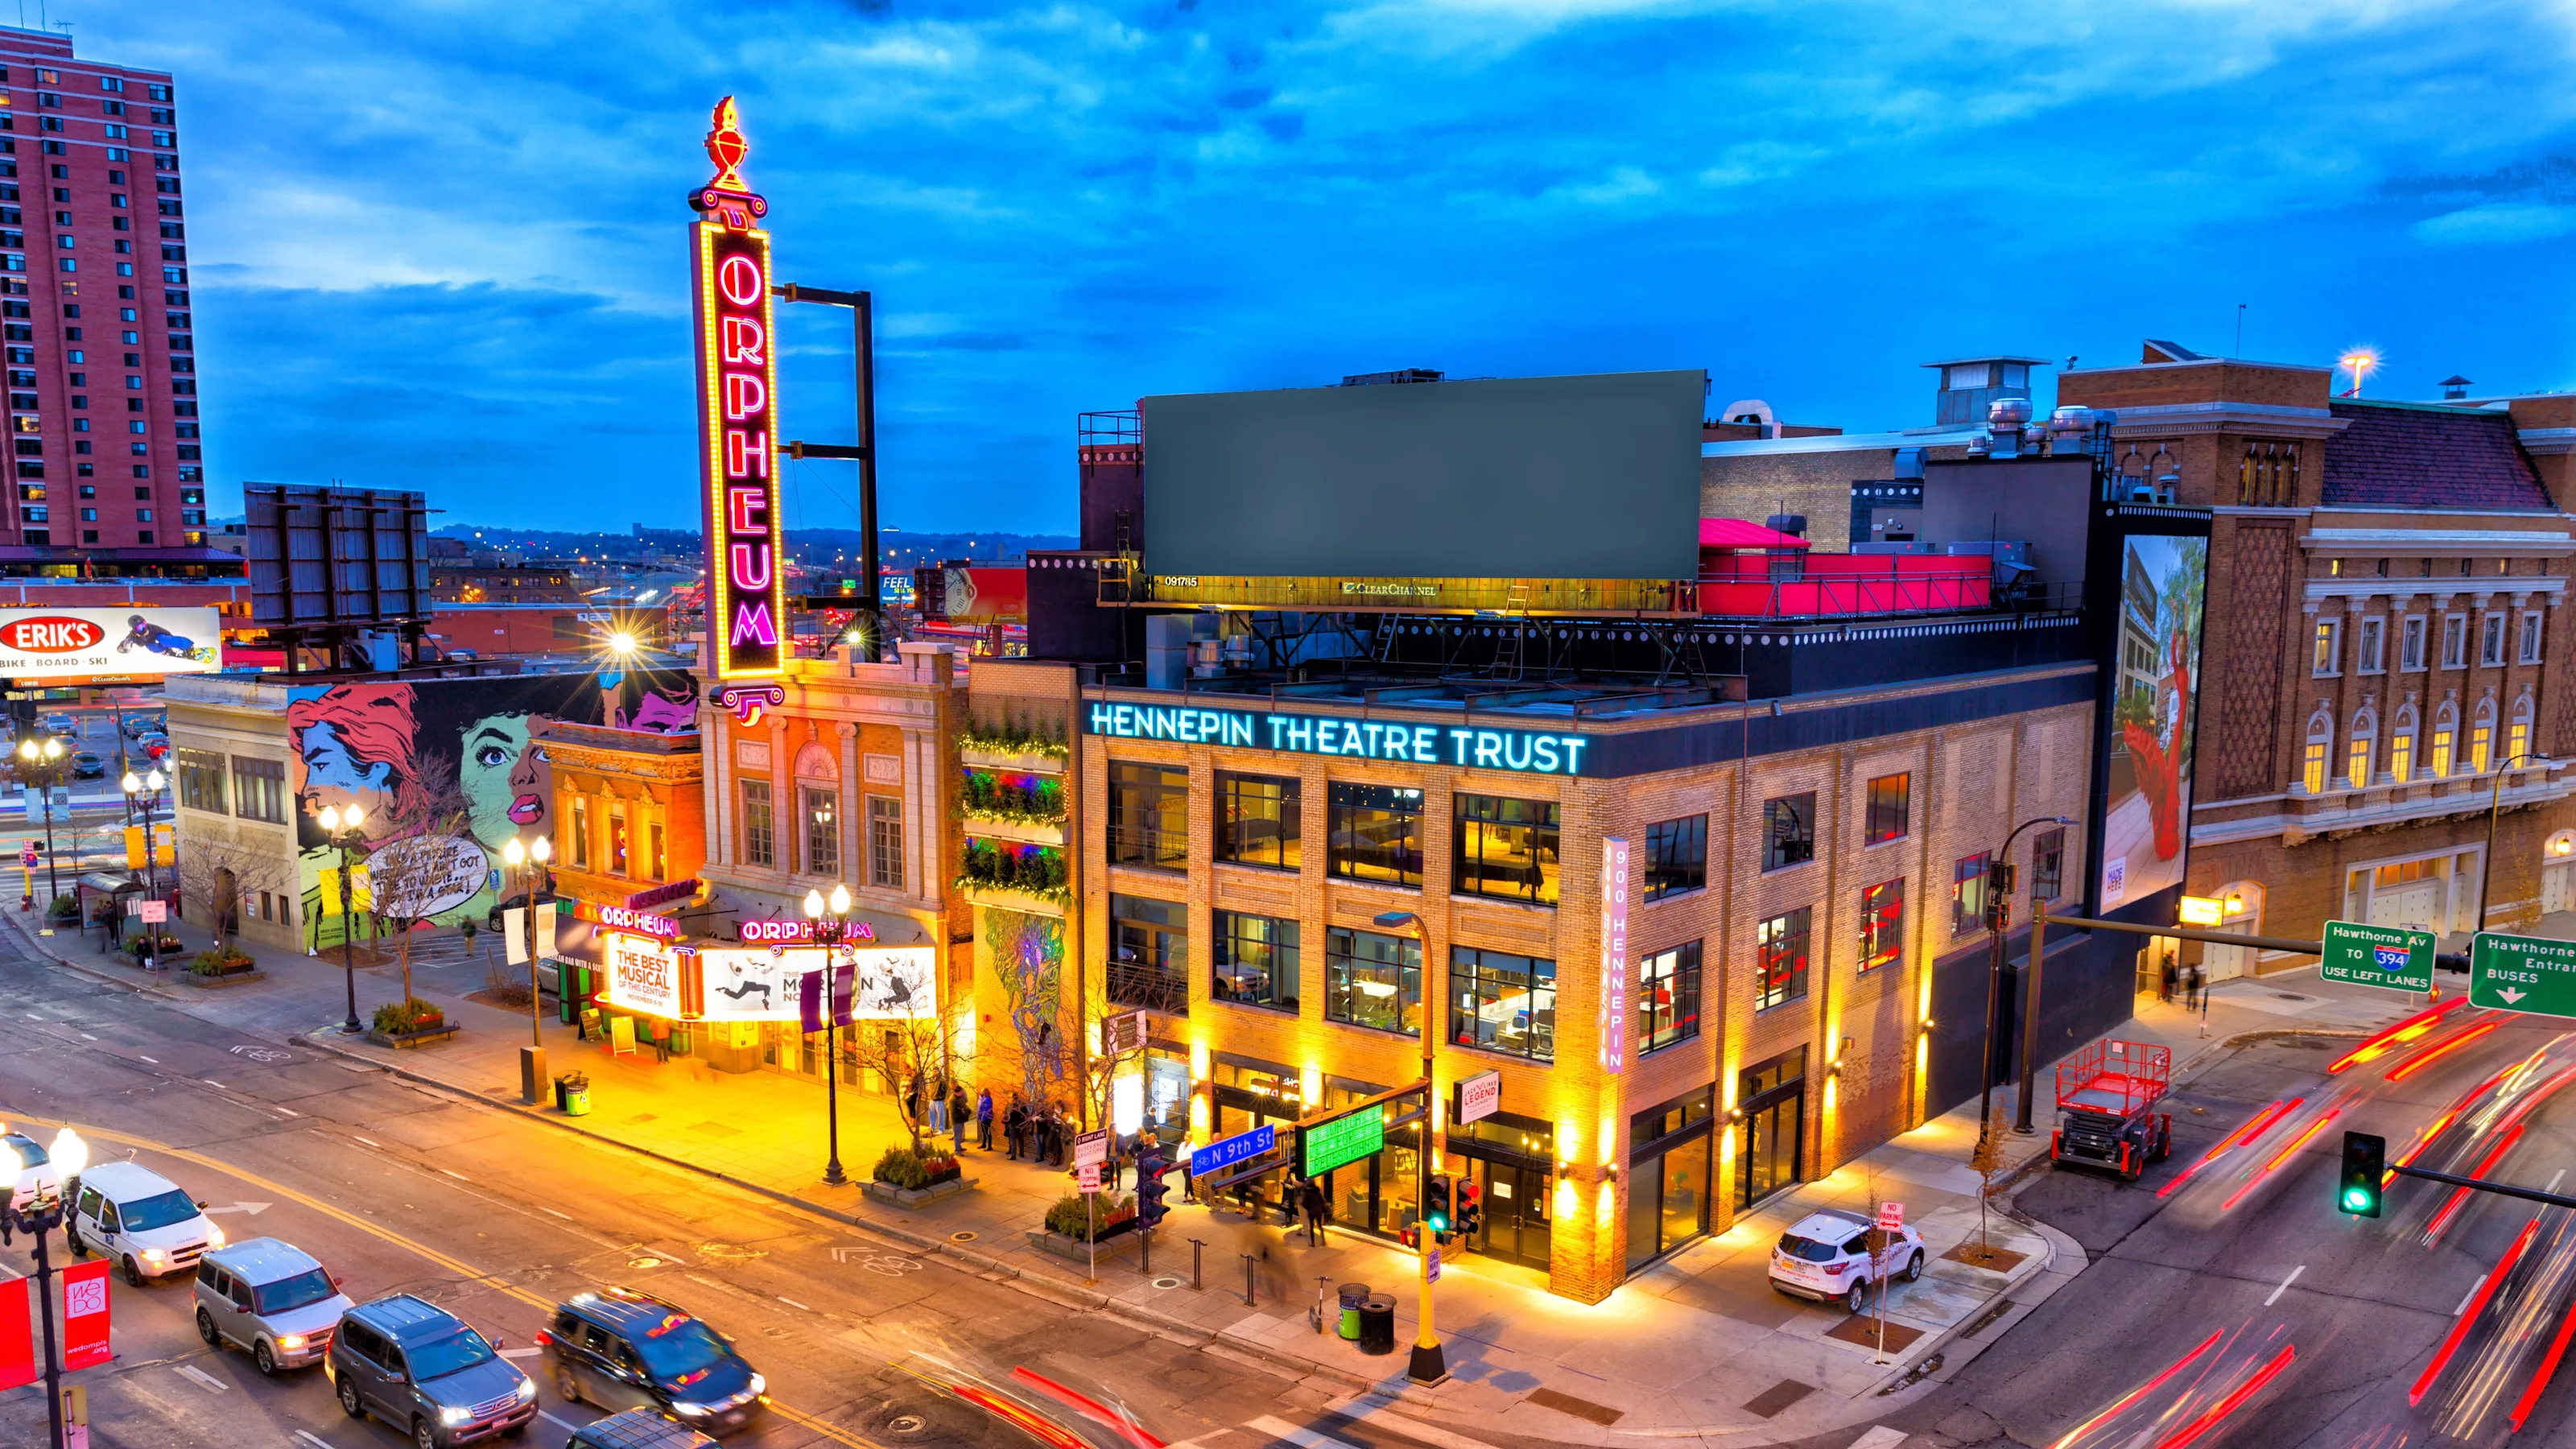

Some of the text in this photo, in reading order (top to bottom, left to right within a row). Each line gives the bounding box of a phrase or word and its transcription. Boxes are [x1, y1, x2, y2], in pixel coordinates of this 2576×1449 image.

[720, 254, 778, 646] ORPHEUM
[16, 622, 91, 647] ERIK'S
[36, 658, 79, 667] BOARD
[1092, 704, 1586, 774] HENNEPIN THEATRE TRUST
[460, 855, 480, 869] GOT
[427, 886, 434, 898] A
[601, 906, 675, 937] ORPHEUM
[2334, 927, 2427, 947] Hawthorne Av
[2346, 948, 2405, 966] TO 394
[2488, 939, 2575, 957] Hawthorne
[564, 956, 575, 966] BAR
[575, 958, 588, 969] WITH
[588, 962, 592, 971] A
[617, 950, 638, 967] THE
[641, 955, 670, 974] BEST
[1610, 850, 1626, 1067] 900 HENNEPIN
[617, 964, 671, 991] MUSICAL
[2325, 966, 2428, 988] USE LEFT LANES
[2487, 968, 2538, 984] BUSES
[618, 980, 671, 999] OF THIS CENTURY
[627, 993, 653, 1005] NOVEMBER
[1464, 1088, 1476, 1097] JACK
[1464, 1087, 1496, 1106] LEGEND
[1472, 1097, 1488, 1108] LOUNGE
[1082, 1131, 1106, 1143] RIGHT LANE
[1212, 1130, 1271, 1165] N 9th St
[1879, 1212, 1902, 1221] PARKING
[1887, 1203, 1897, 1212] NO
[1429, 1260, 1439, 1271] WAY
[1430, 1251, 1439, 1263] ONE
[73, 1296, 101, 1314] DO
[92, 1345, 108, 1355] .org
